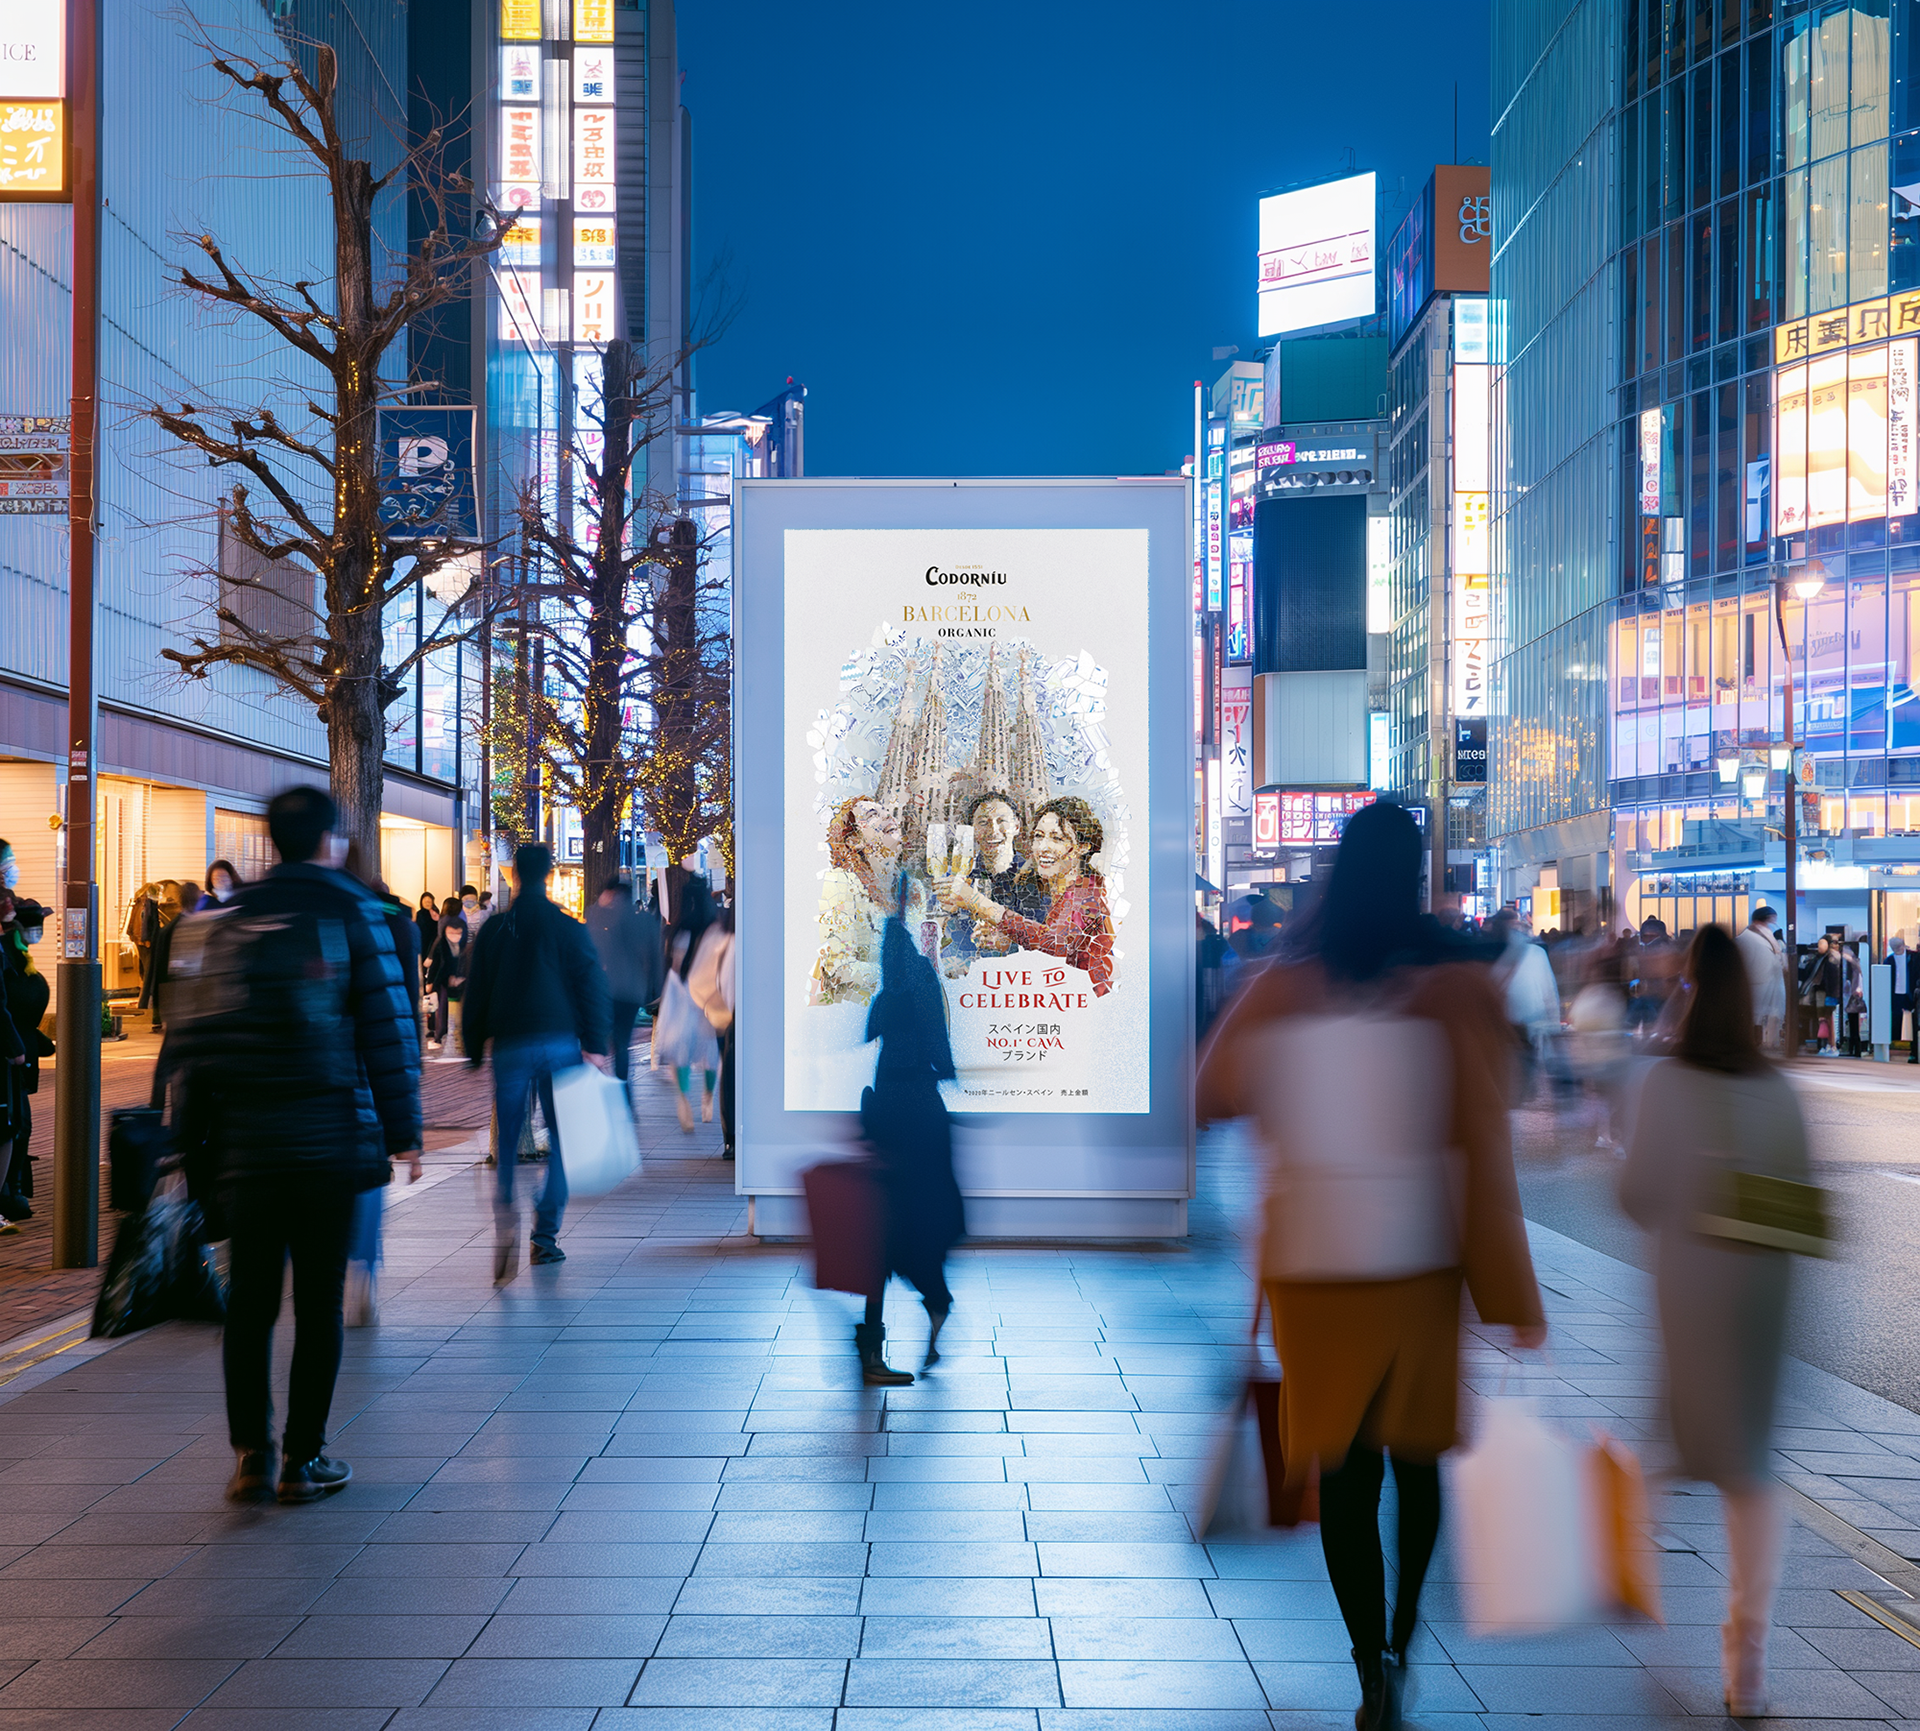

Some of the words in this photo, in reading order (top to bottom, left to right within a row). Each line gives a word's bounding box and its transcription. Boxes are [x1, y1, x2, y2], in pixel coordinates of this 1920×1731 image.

[926, 566, 1007, 587] CODORNÍU
[957, 591, 977, 603] 1872
[902, 605, 1031, 622] BARCELONA
[938, 627, 996, 638] ORGANIC
[982, 970, 1033, 990] LIVE
[1042, 969, 1066, 986] TO
[959, 993, 1088, 1012] CELEBRATE
[988, 1023, 1061, 1035] スペイン国内
[1027, 1035, 1065, 1050] CAVA
[1002, 1049, 1047, 1061] ブランド
[1060, 1088, 1089, 1097] 売上金額
